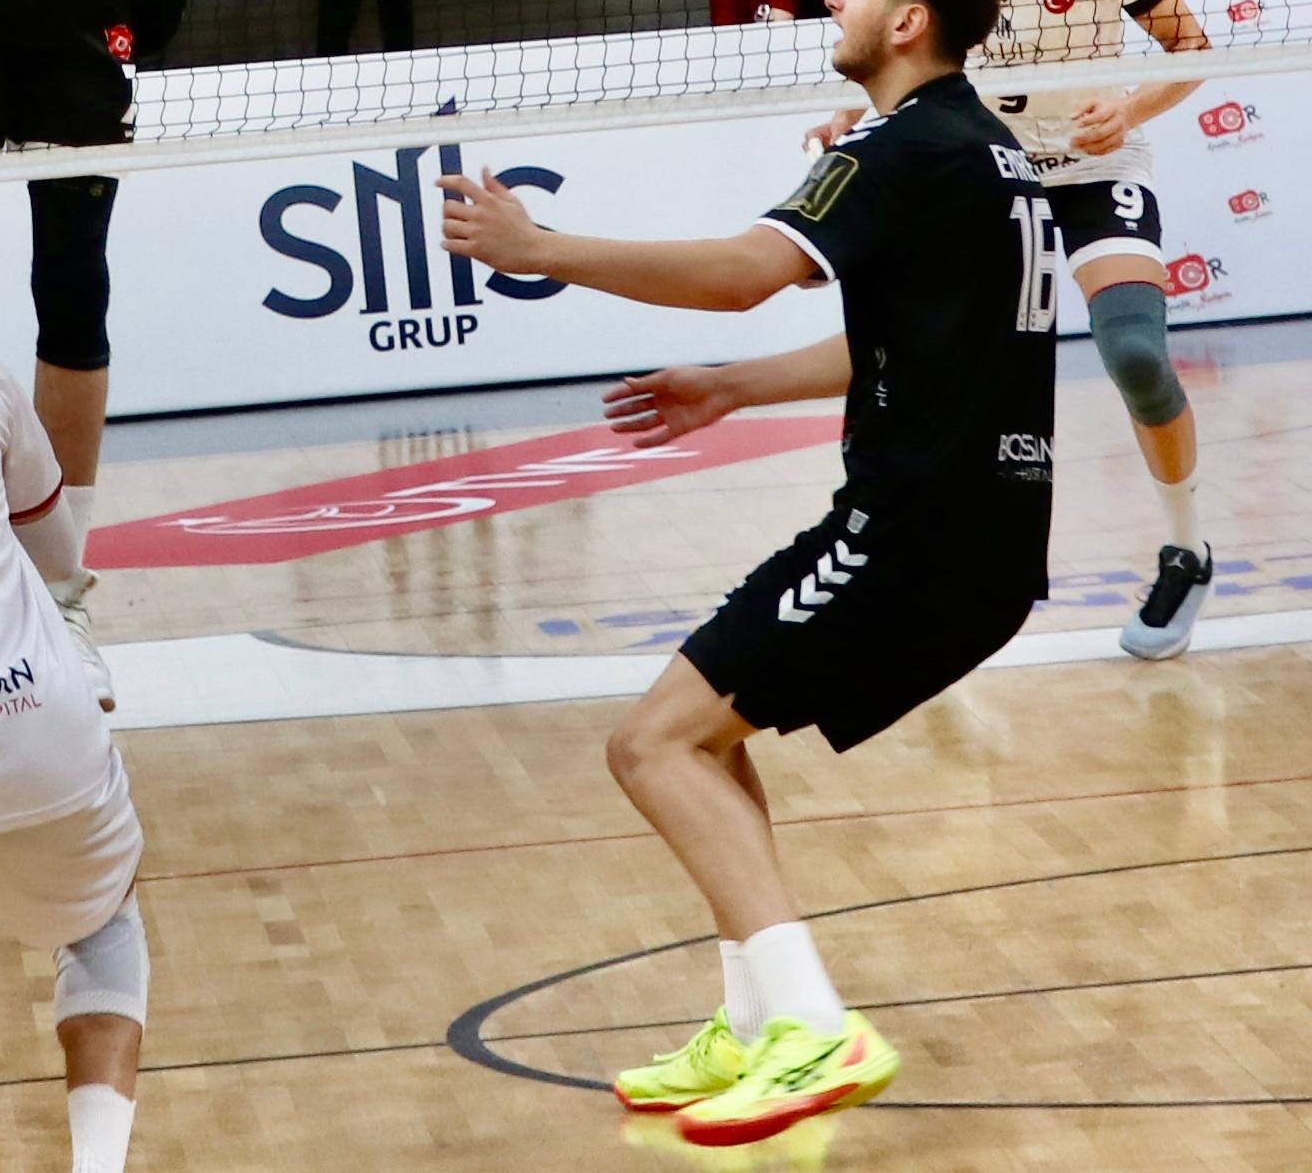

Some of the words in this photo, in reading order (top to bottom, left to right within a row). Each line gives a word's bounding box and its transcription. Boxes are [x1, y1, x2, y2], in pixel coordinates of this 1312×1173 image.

[259, 96, 571, 319] SMS
[1111, 182, 1145, 220] 9
[1009, 195, 1056, 333] 16
[368, 313, 479, 353] GRUP
